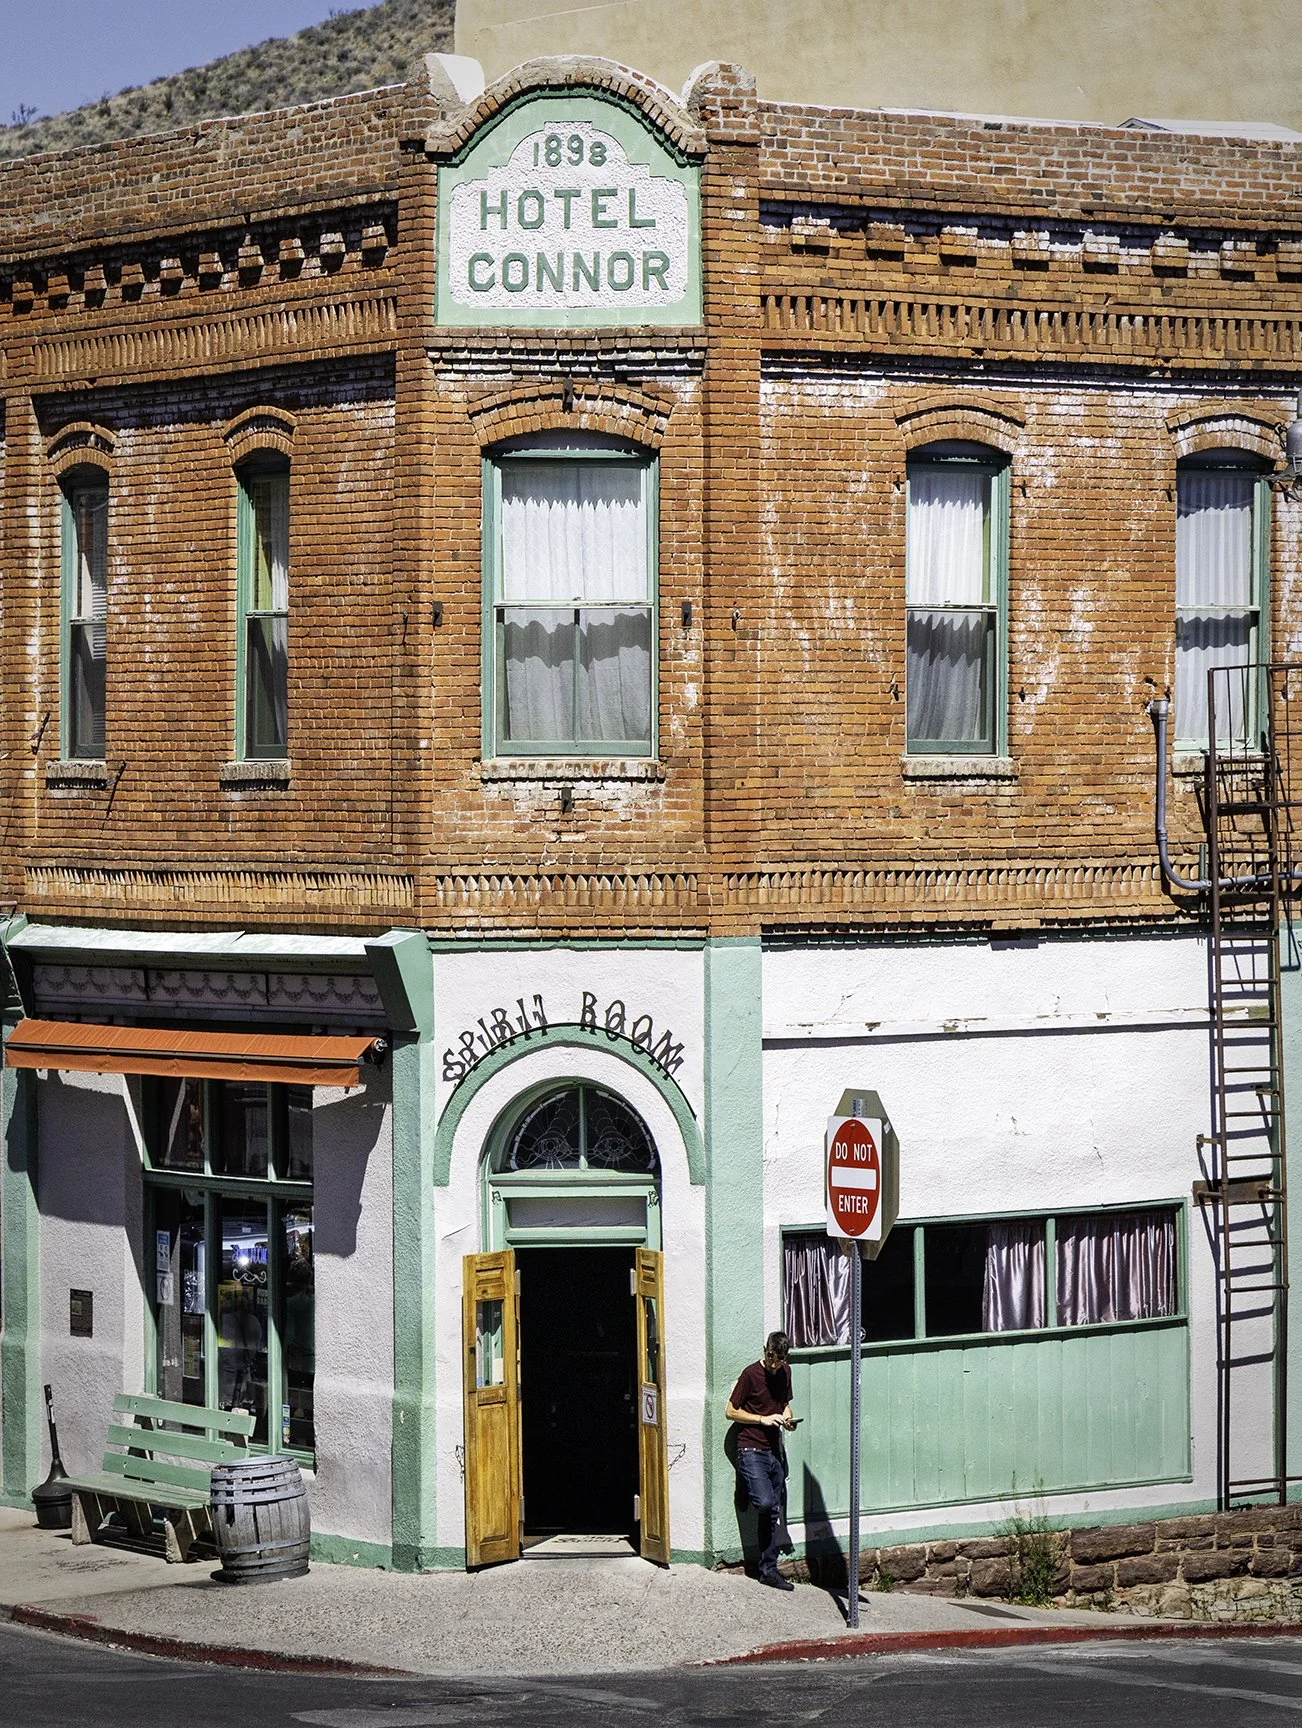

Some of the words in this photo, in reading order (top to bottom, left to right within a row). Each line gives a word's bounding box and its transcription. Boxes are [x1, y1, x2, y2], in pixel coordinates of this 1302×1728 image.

[532, 134, 608, 167] 1898
[480, 187, 657, 230] HOTEL
[467, 251, 671, 292] CONNOR
[442, 993, 548, 1083] SPIRIT
[579, 991, 685, 1077] ROOM
[835, 1141, 848, 1161] DO
[853, 1143, 872, 1162] NOT
[838, 1194, 868, 1214] ENTER
